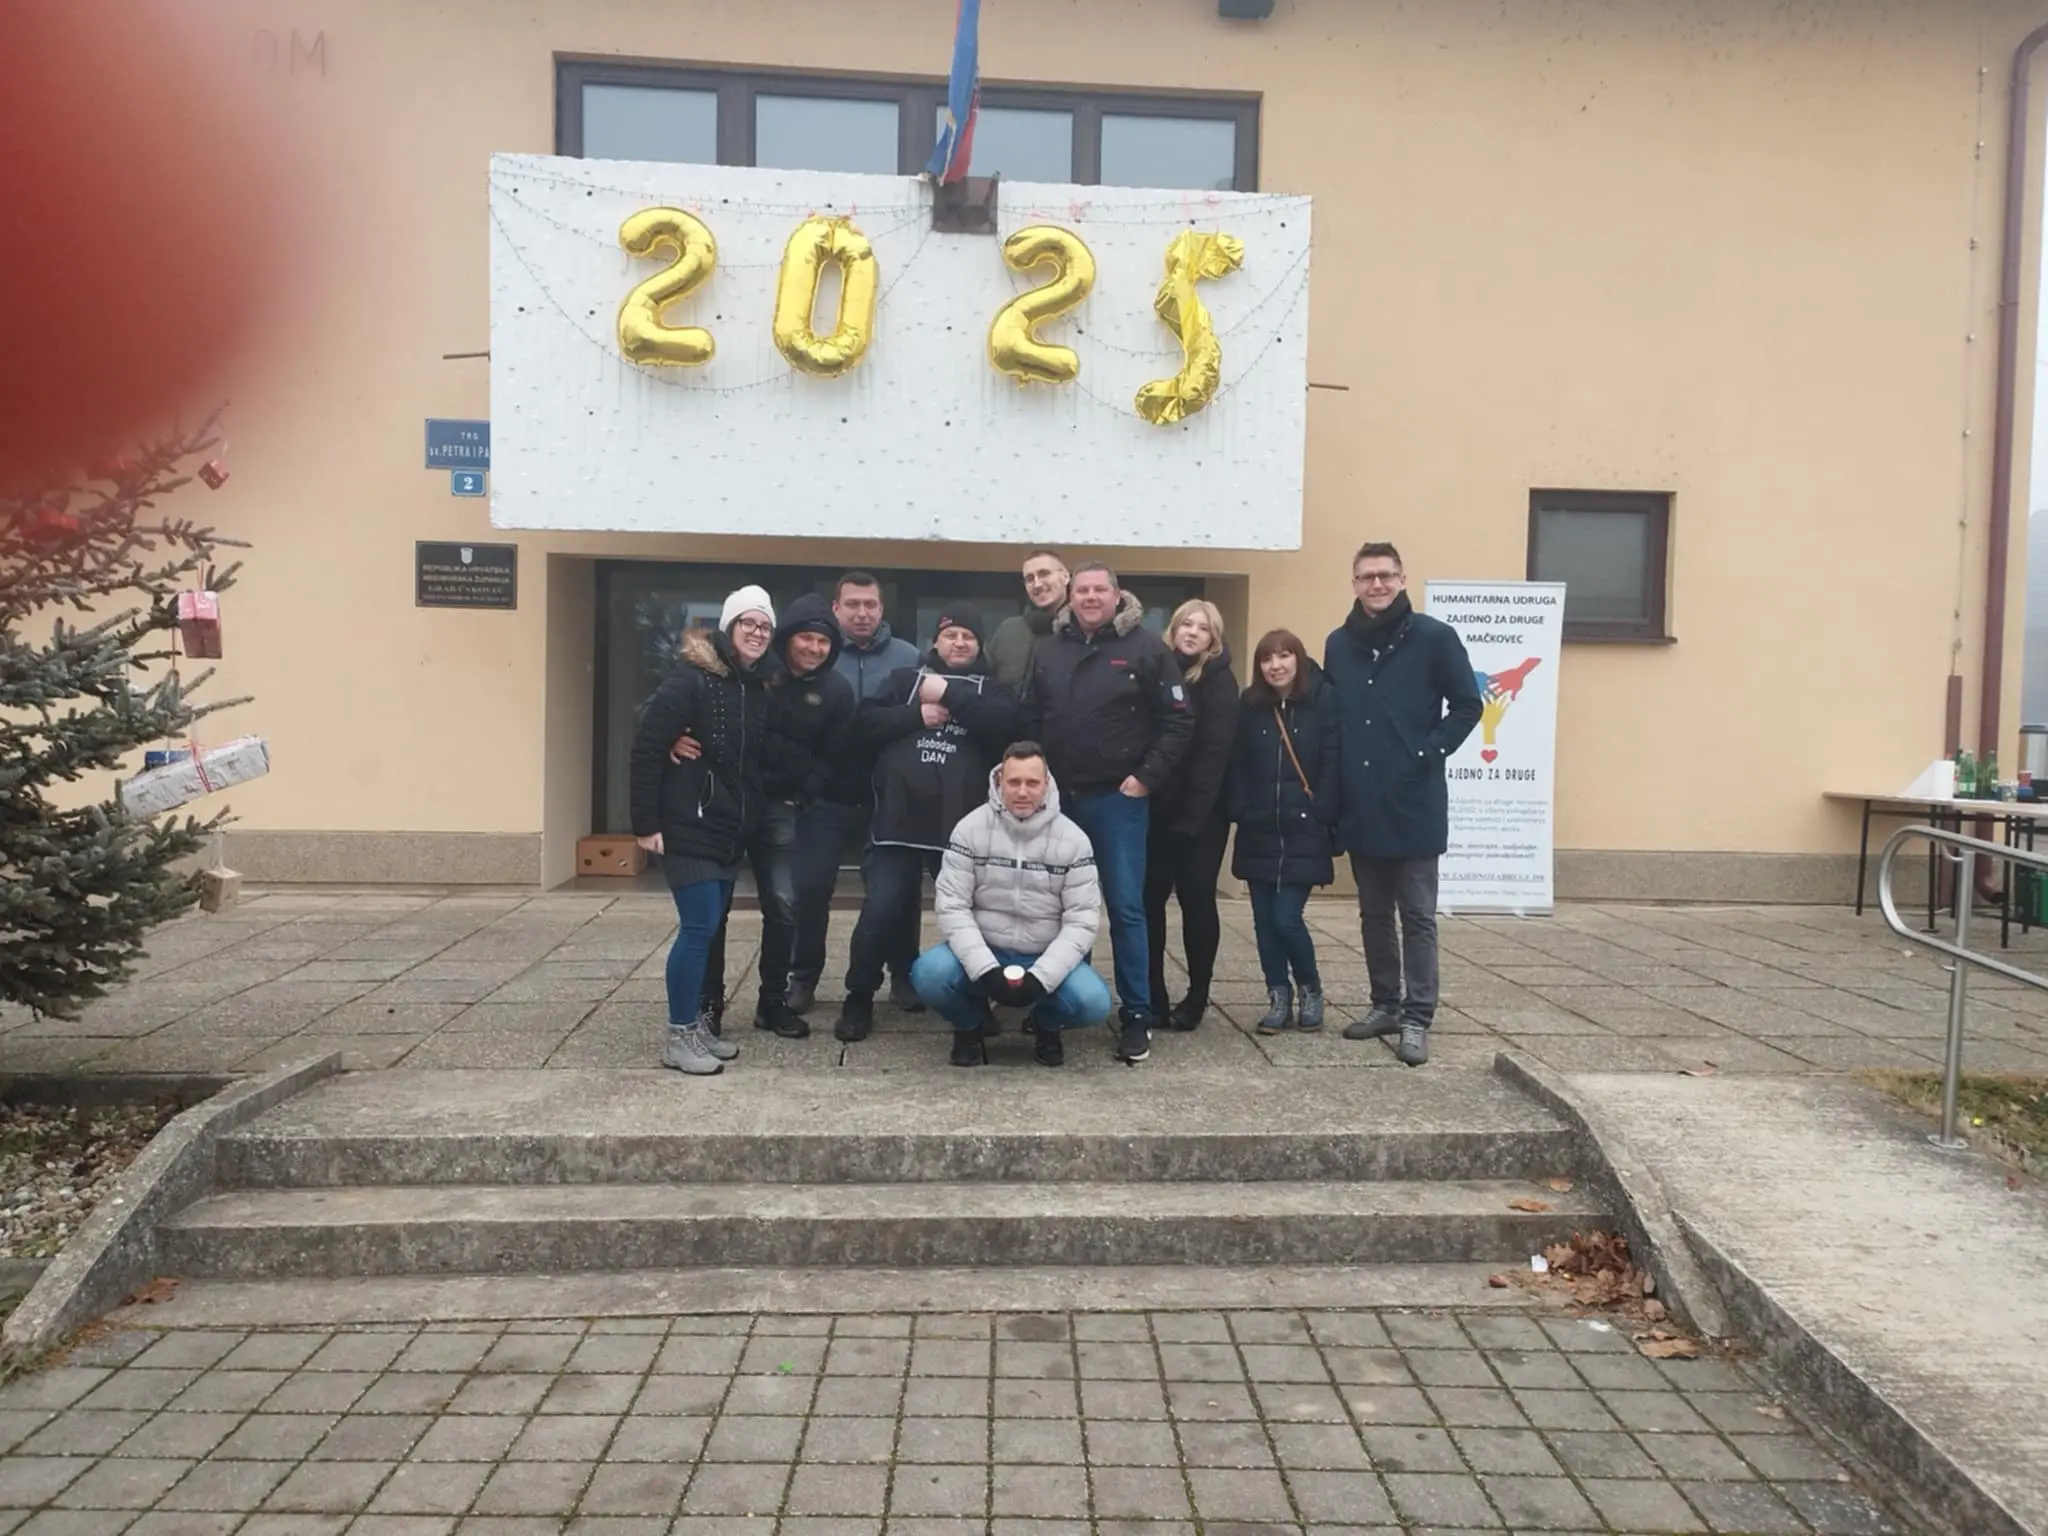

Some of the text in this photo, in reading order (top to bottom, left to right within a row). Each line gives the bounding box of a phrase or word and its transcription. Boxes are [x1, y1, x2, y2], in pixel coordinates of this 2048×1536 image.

[463, 476, 474, 490] 2
[1432, 594, 1557, 605] HUMANITARNA UDRUGA
[1446, 614, 1545, 625] ZAJEDNO ZA DRUGE
[1466, 632, 1524, 644] MAČKOVEC
[916, 736, 957, 753] slobodan
[920, 750, 947, 764] DAN
[1445, 768, 1536, 781] AJEDNO ZA DRUGE
